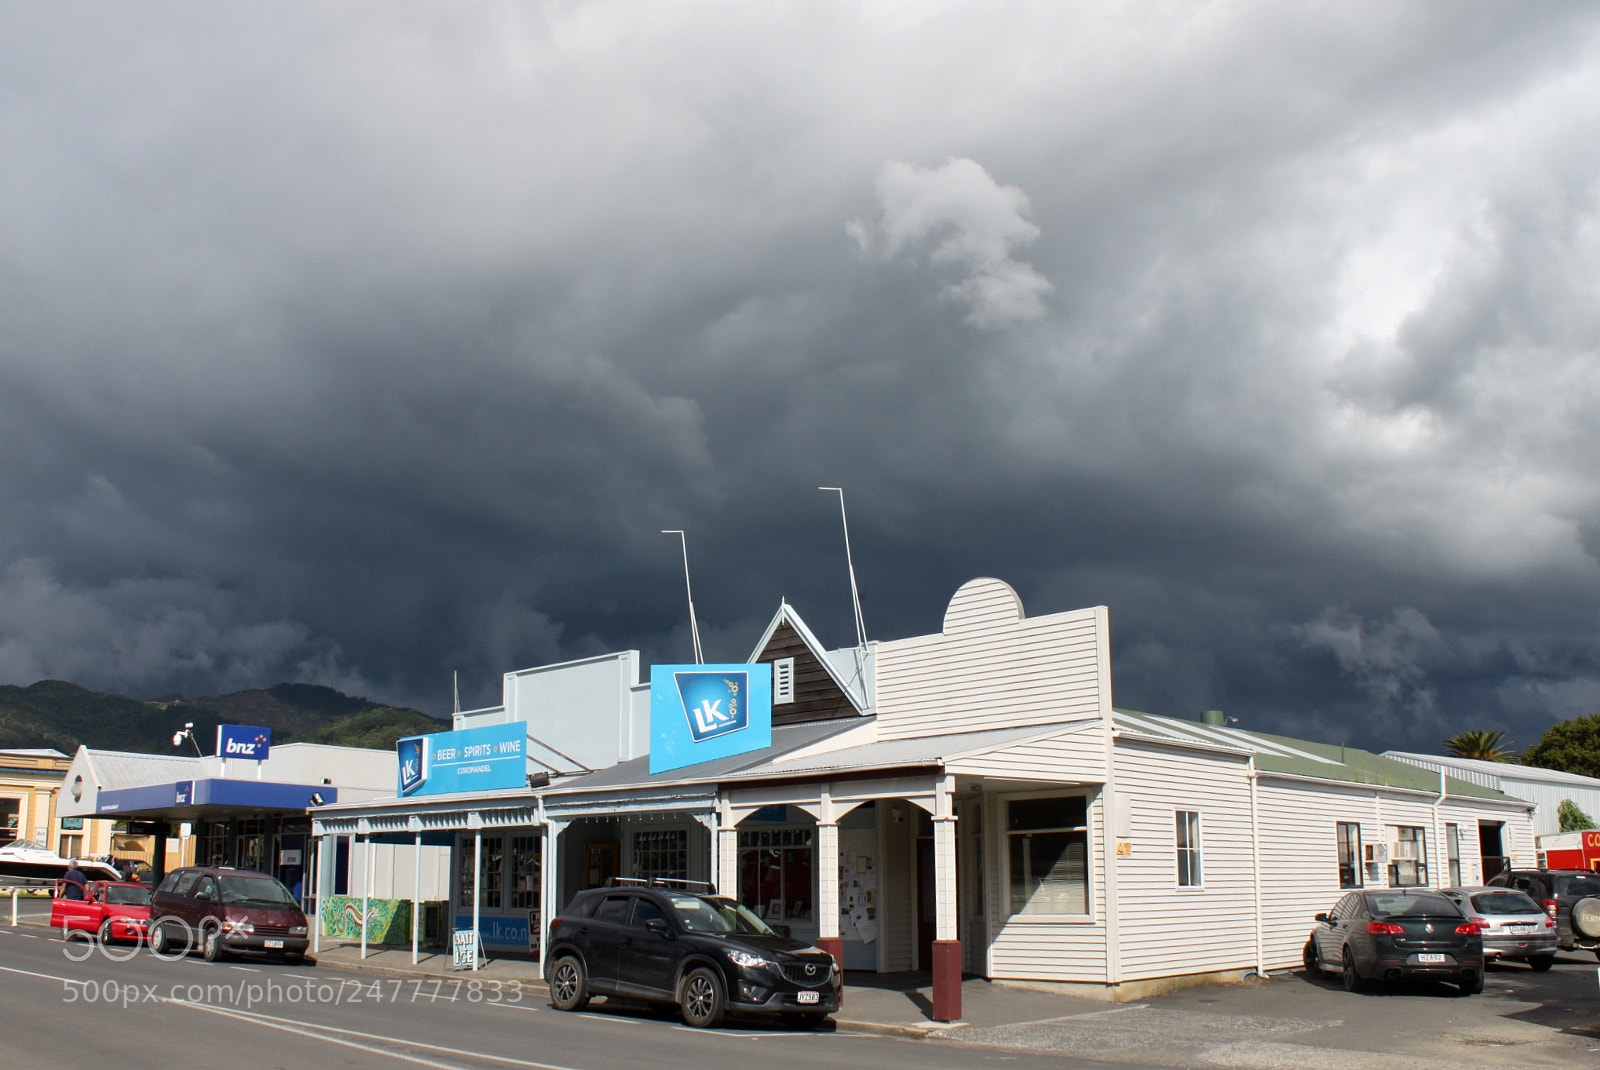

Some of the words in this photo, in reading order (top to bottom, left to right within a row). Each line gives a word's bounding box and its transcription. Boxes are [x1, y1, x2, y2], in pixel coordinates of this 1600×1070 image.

[692, 699, 729, 733] LK
[226, 738, 255, 755] bnz
[437, 748, 456, 761] BEER
[464, 744, 491, 758] SPIRITS
[499, 740, 520, 753] WINE
[457, 765, 491, 775] COROMANDEL
[455, 933, 474, 945] BAIT
[455, 950, 474, 964] ICE
